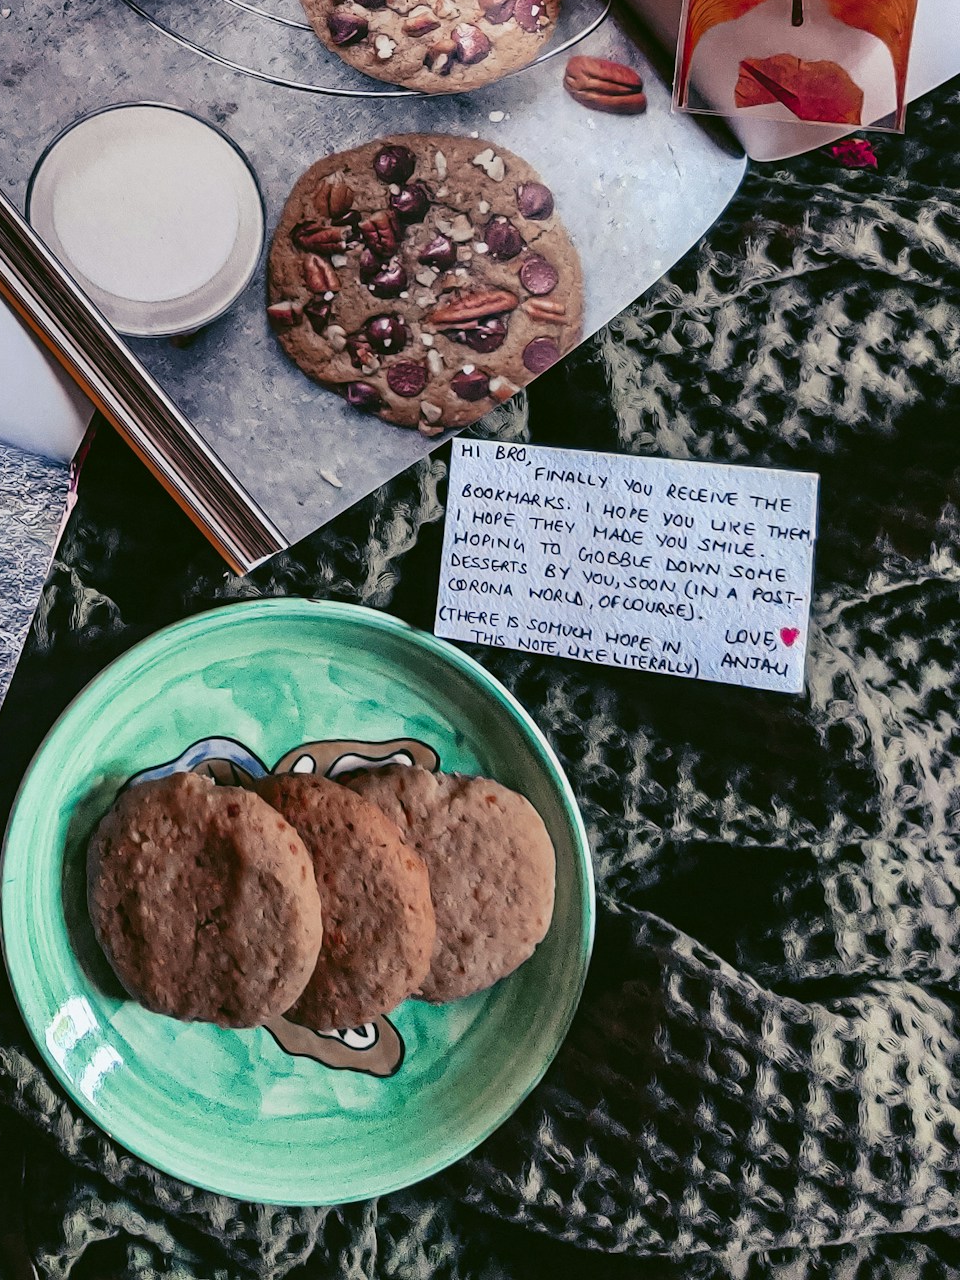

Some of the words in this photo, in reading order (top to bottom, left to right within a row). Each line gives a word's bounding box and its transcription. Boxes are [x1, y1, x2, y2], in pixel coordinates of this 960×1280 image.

[461, 444, 480, 458] HI
[495, 445, 533, 465] BRO,
[461, 484, 571, 510] BOOKMARKS.
[602, 504, 648, 523] HOPE
[662, 513, 694, 529] YOU
[710, 518, 756, 535] LIKE
[534, 467, 607, 488] FINALLY
[622, 478, 652, 496] YOU
[665, 483, 739, 506] RECEIVE
[749, 494, 791, 512] THE
[453, 531, 525, 553] HOPING
[539, 542, 561, 555] TO
[577, 546, 652, 569] GOBBLE
[665, 557, 720, 576] DOWN
[729, 563, 786, 583] SOME
[472, 509, 515, 527] HOPE
[528, 516, 575, 534] THEY
[592, 526, 643, 545] MADE
[655, 533, 687, 549] YOU
[697, 537, 765, 558] SMILE.
[450, 553, 528, 574] DESSERTS
[544, 564, 570, 580] BY
[683, 579, 718, 601] (IN
[726, 587, 738, 600] A
[751, 587, 803, 610] POST-
[439, 605, 499, 626] (THERE
[507, 615, 518, 627] IS
[604, 632, 651, 650] HOPE
[662, 640, 681, 654] IN
[469, 629, 505, 646] THIS
[567, 646, 607, 662] LIKE
[613, 649, 700, 678] LITERALLY)
[724, 627, 778, 651] LOVE,
